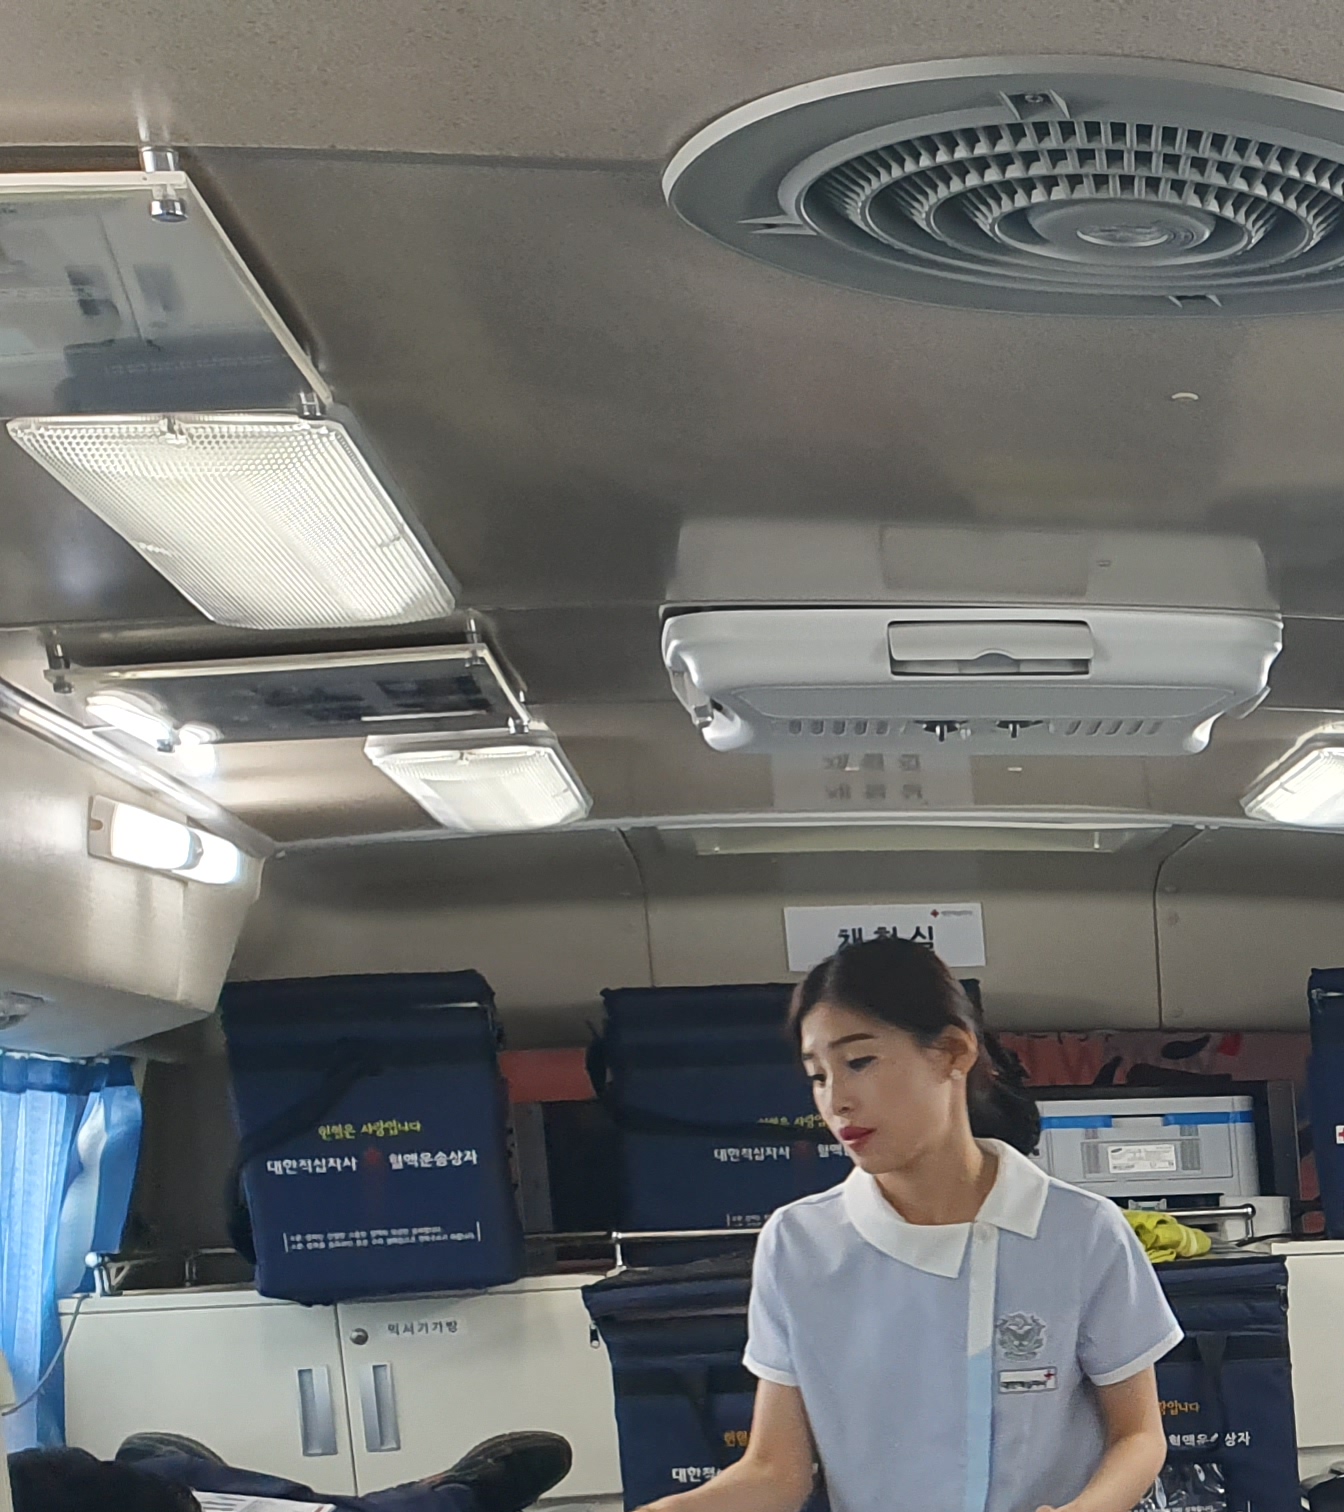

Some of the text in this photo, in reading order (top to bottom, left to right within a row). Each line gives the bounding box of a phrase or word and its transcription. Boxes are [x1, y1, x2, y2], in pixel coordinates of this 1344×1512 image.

[361, 1118, 421, 1137] 사랑입니다
[266, 1149, 478, 1175] 대한적십자사 혈액운송상자
[713, 1146, 790, 1162] 대한적십자사
